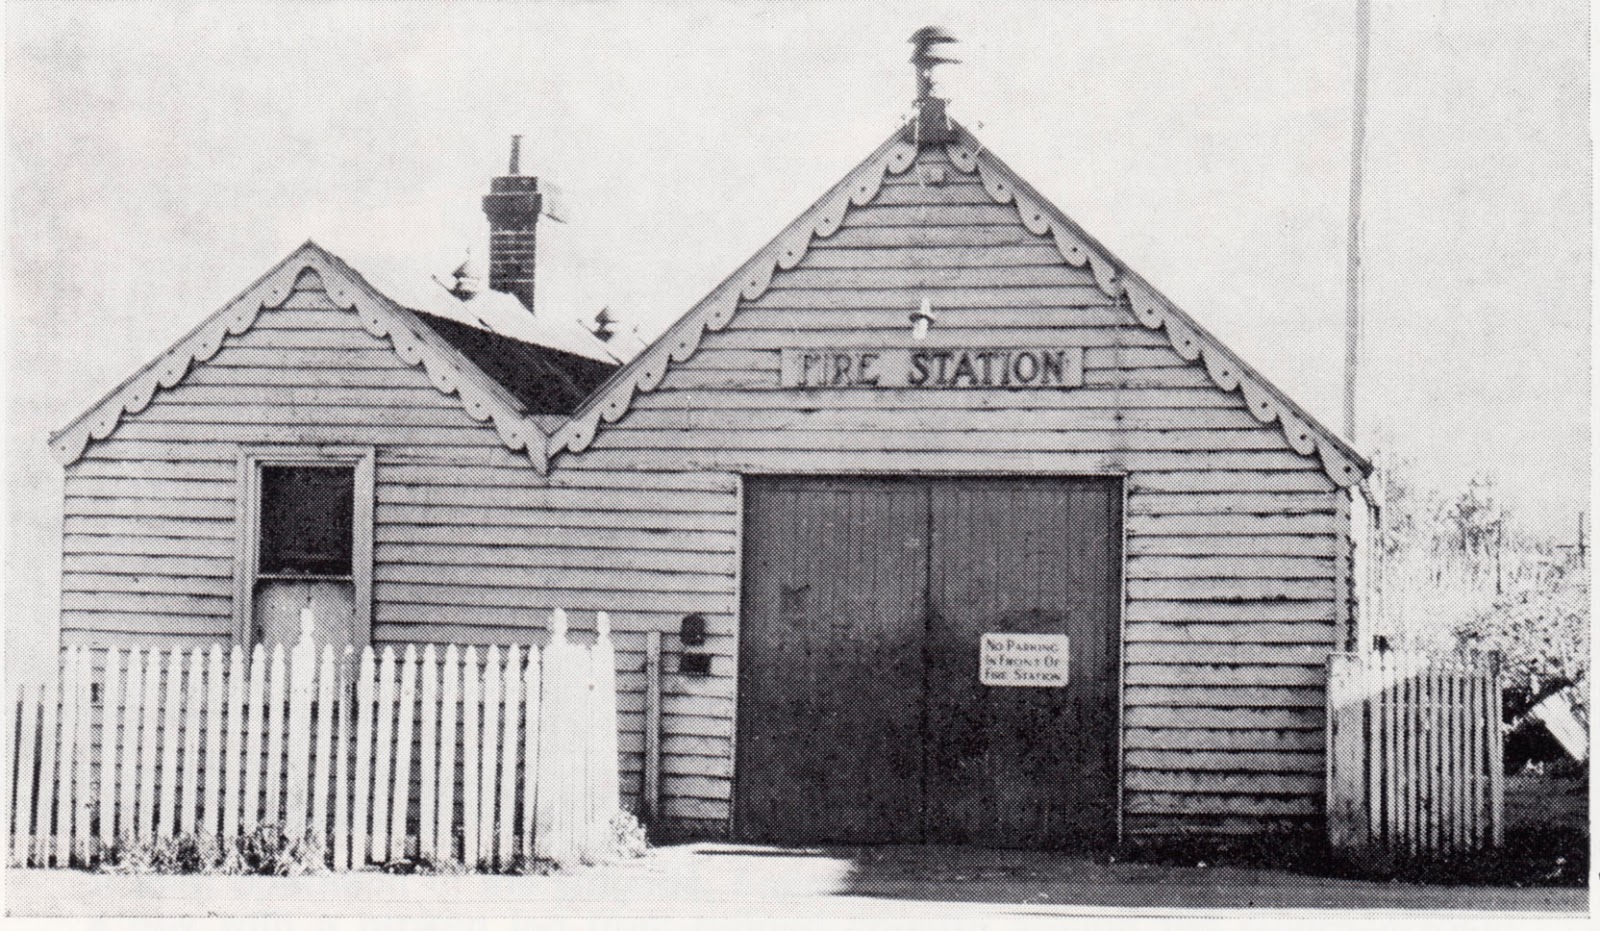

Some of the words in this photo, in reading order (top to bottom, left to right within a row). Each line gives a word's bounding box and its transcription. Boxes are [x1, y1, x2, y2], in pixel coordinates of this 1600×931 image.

[799, 352, 880, 387] FIRE
[908, 351, 1066, 387] STATION
[986, 638, 1004, 652] NO
[1006, 638, 1059, 653] PARKING
[999, 654, 1040, 667] FRONT
[1044, 655, 1060, 668] OF
[985, 667, 1007, 680] FIRE
[1014, 668, 1062, 681] STATION
